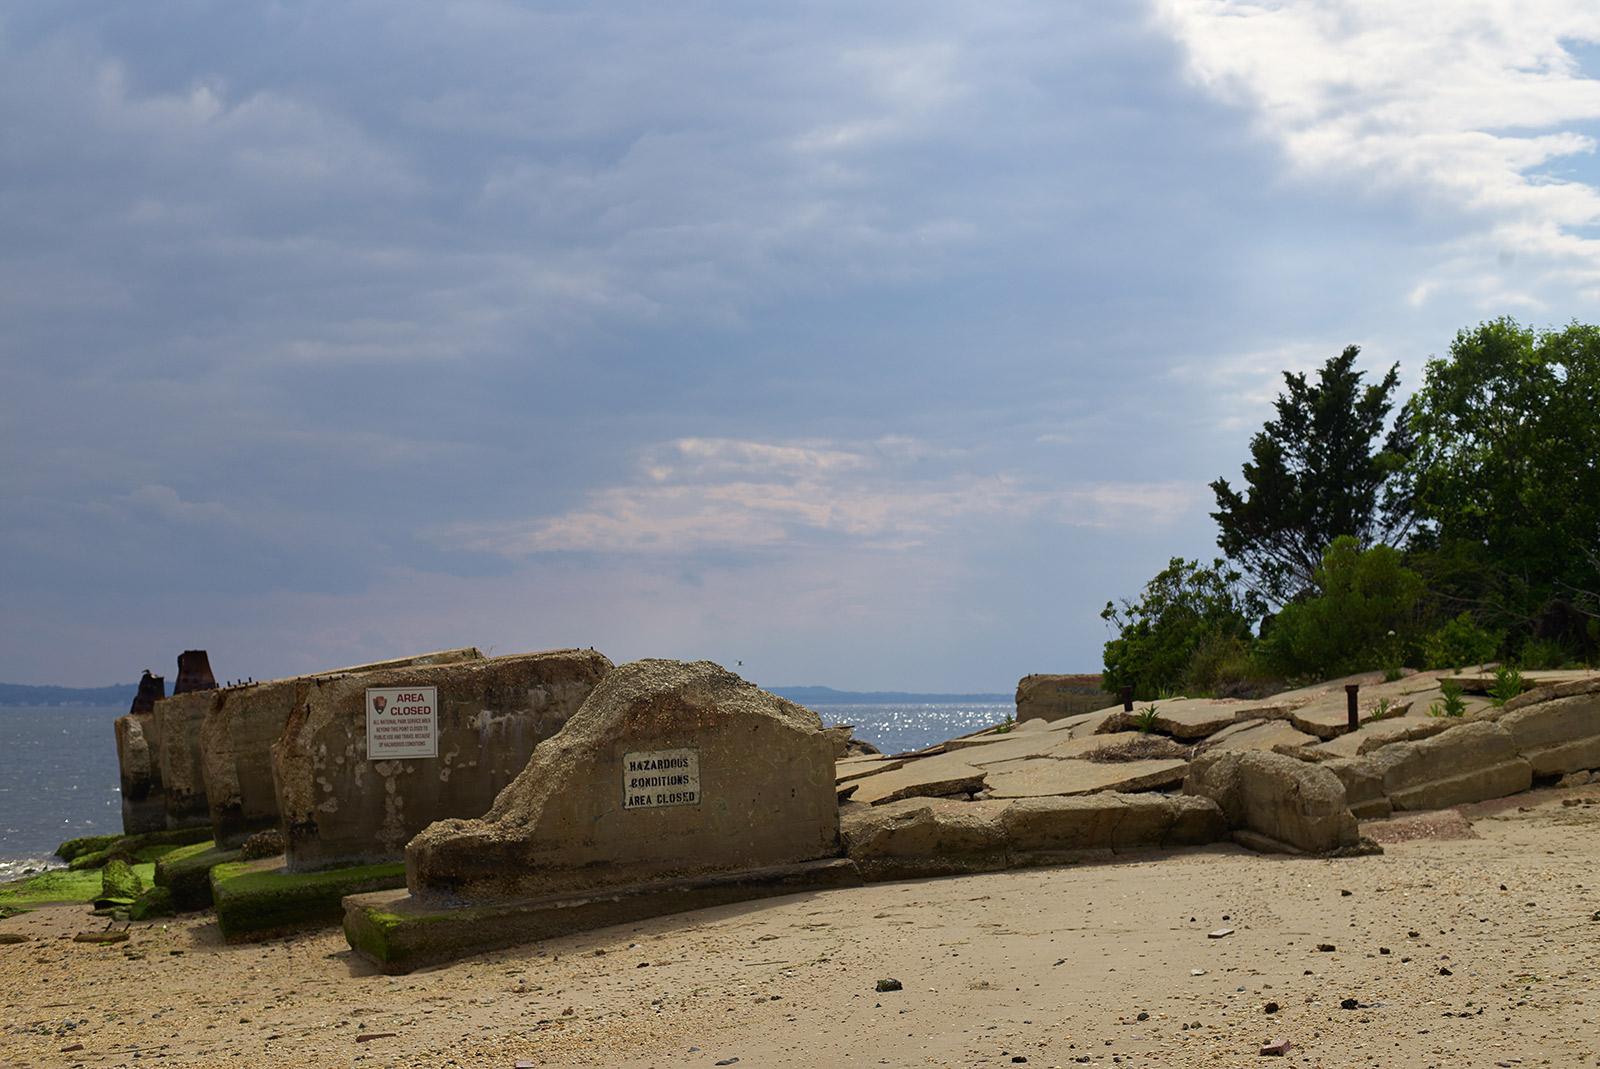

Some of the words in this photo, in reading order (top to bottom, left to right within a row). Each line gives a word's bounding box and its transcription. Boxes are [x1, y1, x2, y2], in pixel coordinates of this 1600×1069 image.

[396, 693, 424, 702] AREA
[390, 706, 431, 716] CLOSED
[630, 758, 688, 772] HAZARDOUS
[631, 775, 689, 788] CONDITIONS
[628, 794, 652, 806] AREA
[657, 792, 695, 804] CLOSED
